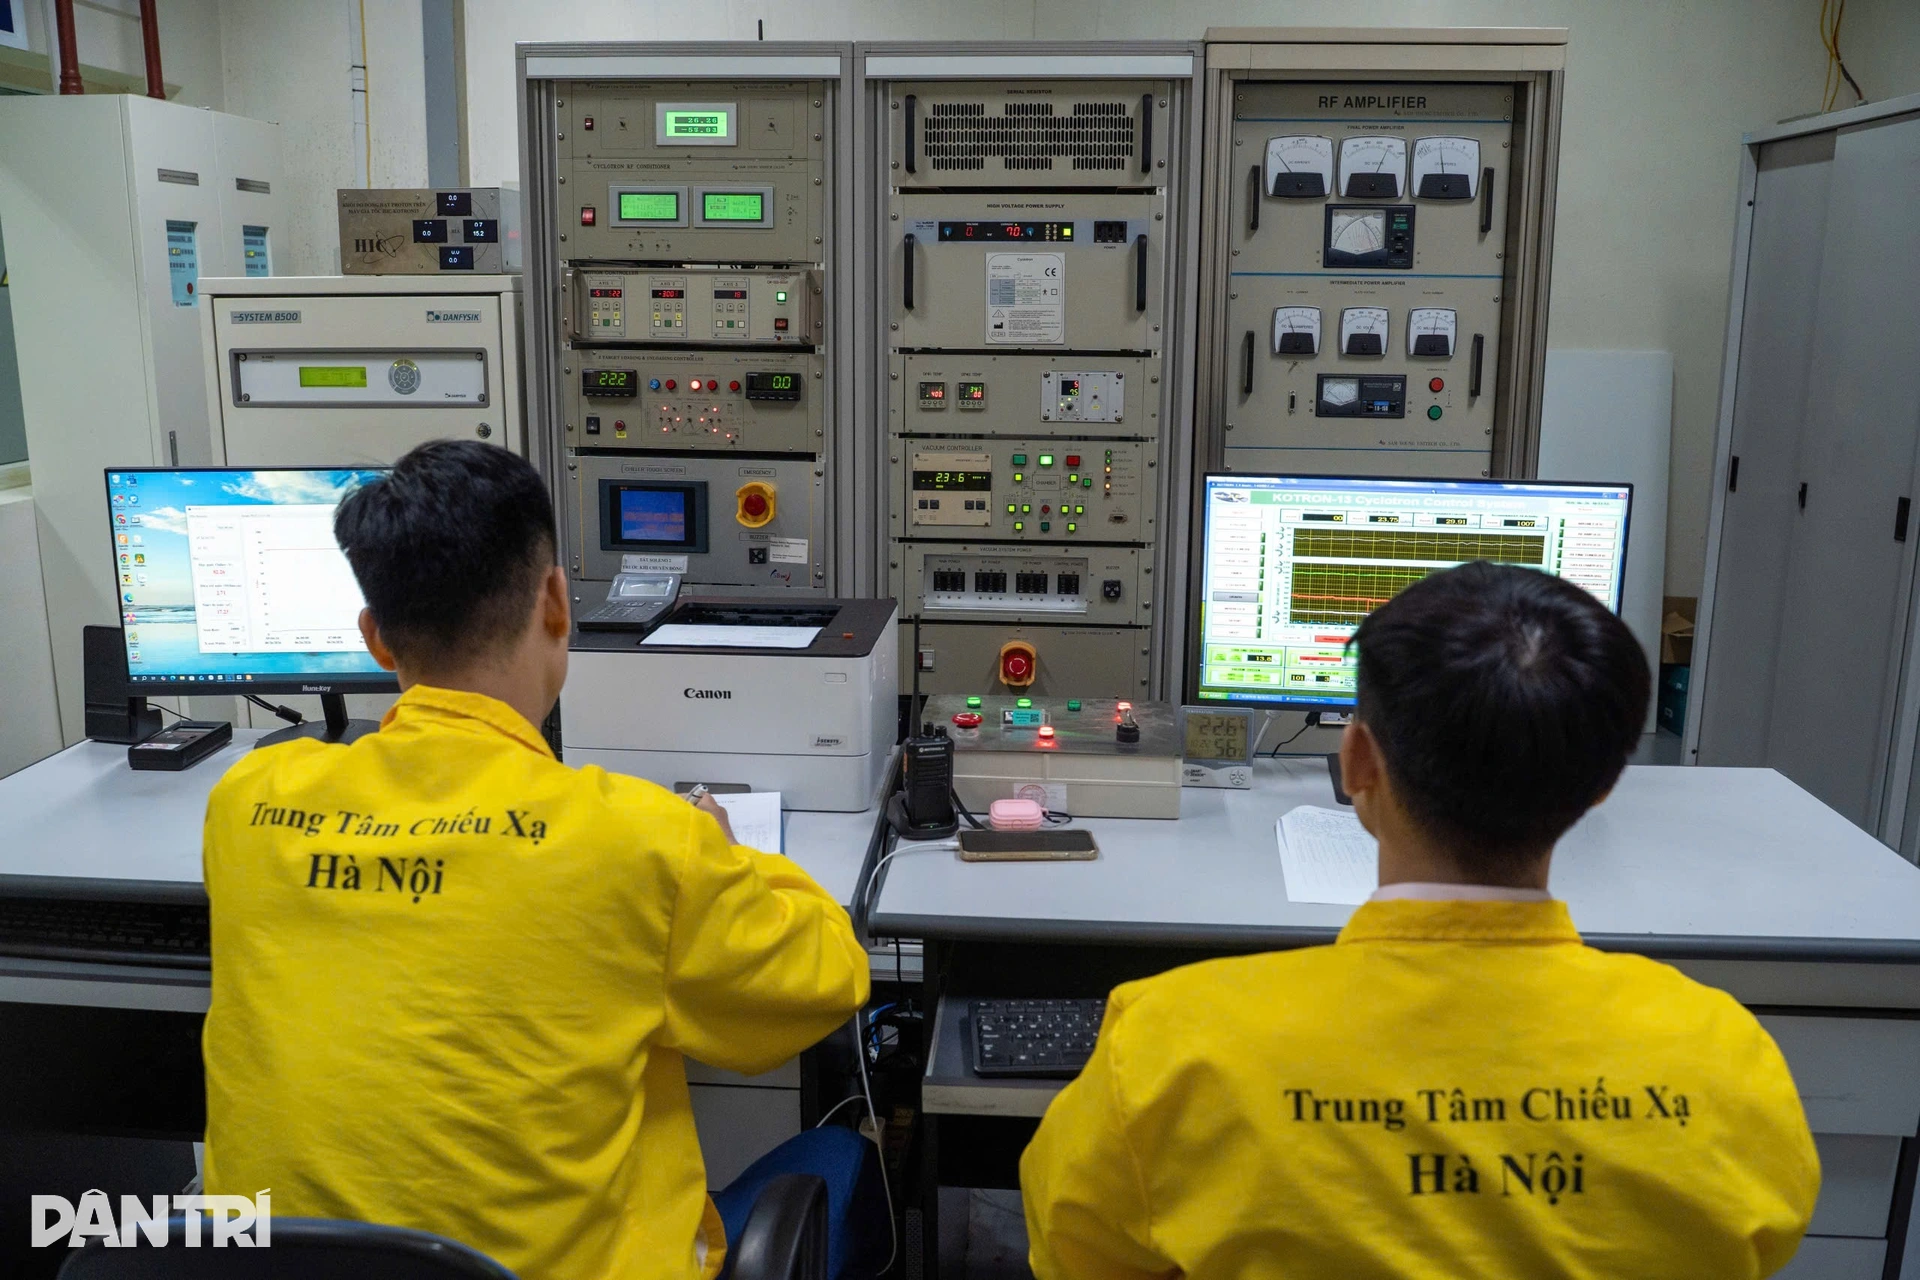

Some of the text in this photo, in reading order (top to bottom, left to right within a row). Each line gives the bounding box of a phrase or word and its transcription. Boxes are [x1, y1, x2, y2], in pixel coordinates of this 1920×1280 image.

[1318, 96, 1427, 109] RF AMPLIFIER
[238, 312, 298, 322] SYSTEM 8500
[442, 313, 480, 322] DANFYSIK
[1272, 493, 1525, 510] KOTRON-13 Cyclotron Control System
[683, 687, 732, 700] Canon
[248, 801, 547, 846] Trung Tâm Chiếu Xạ
[304, 853, 446, 905] Hà Nội
[1283, 1077, 1691, 1131] Trung Tâm Chiếu Xạ
[1406, 1150, 1586, 1205] Hà Nội
